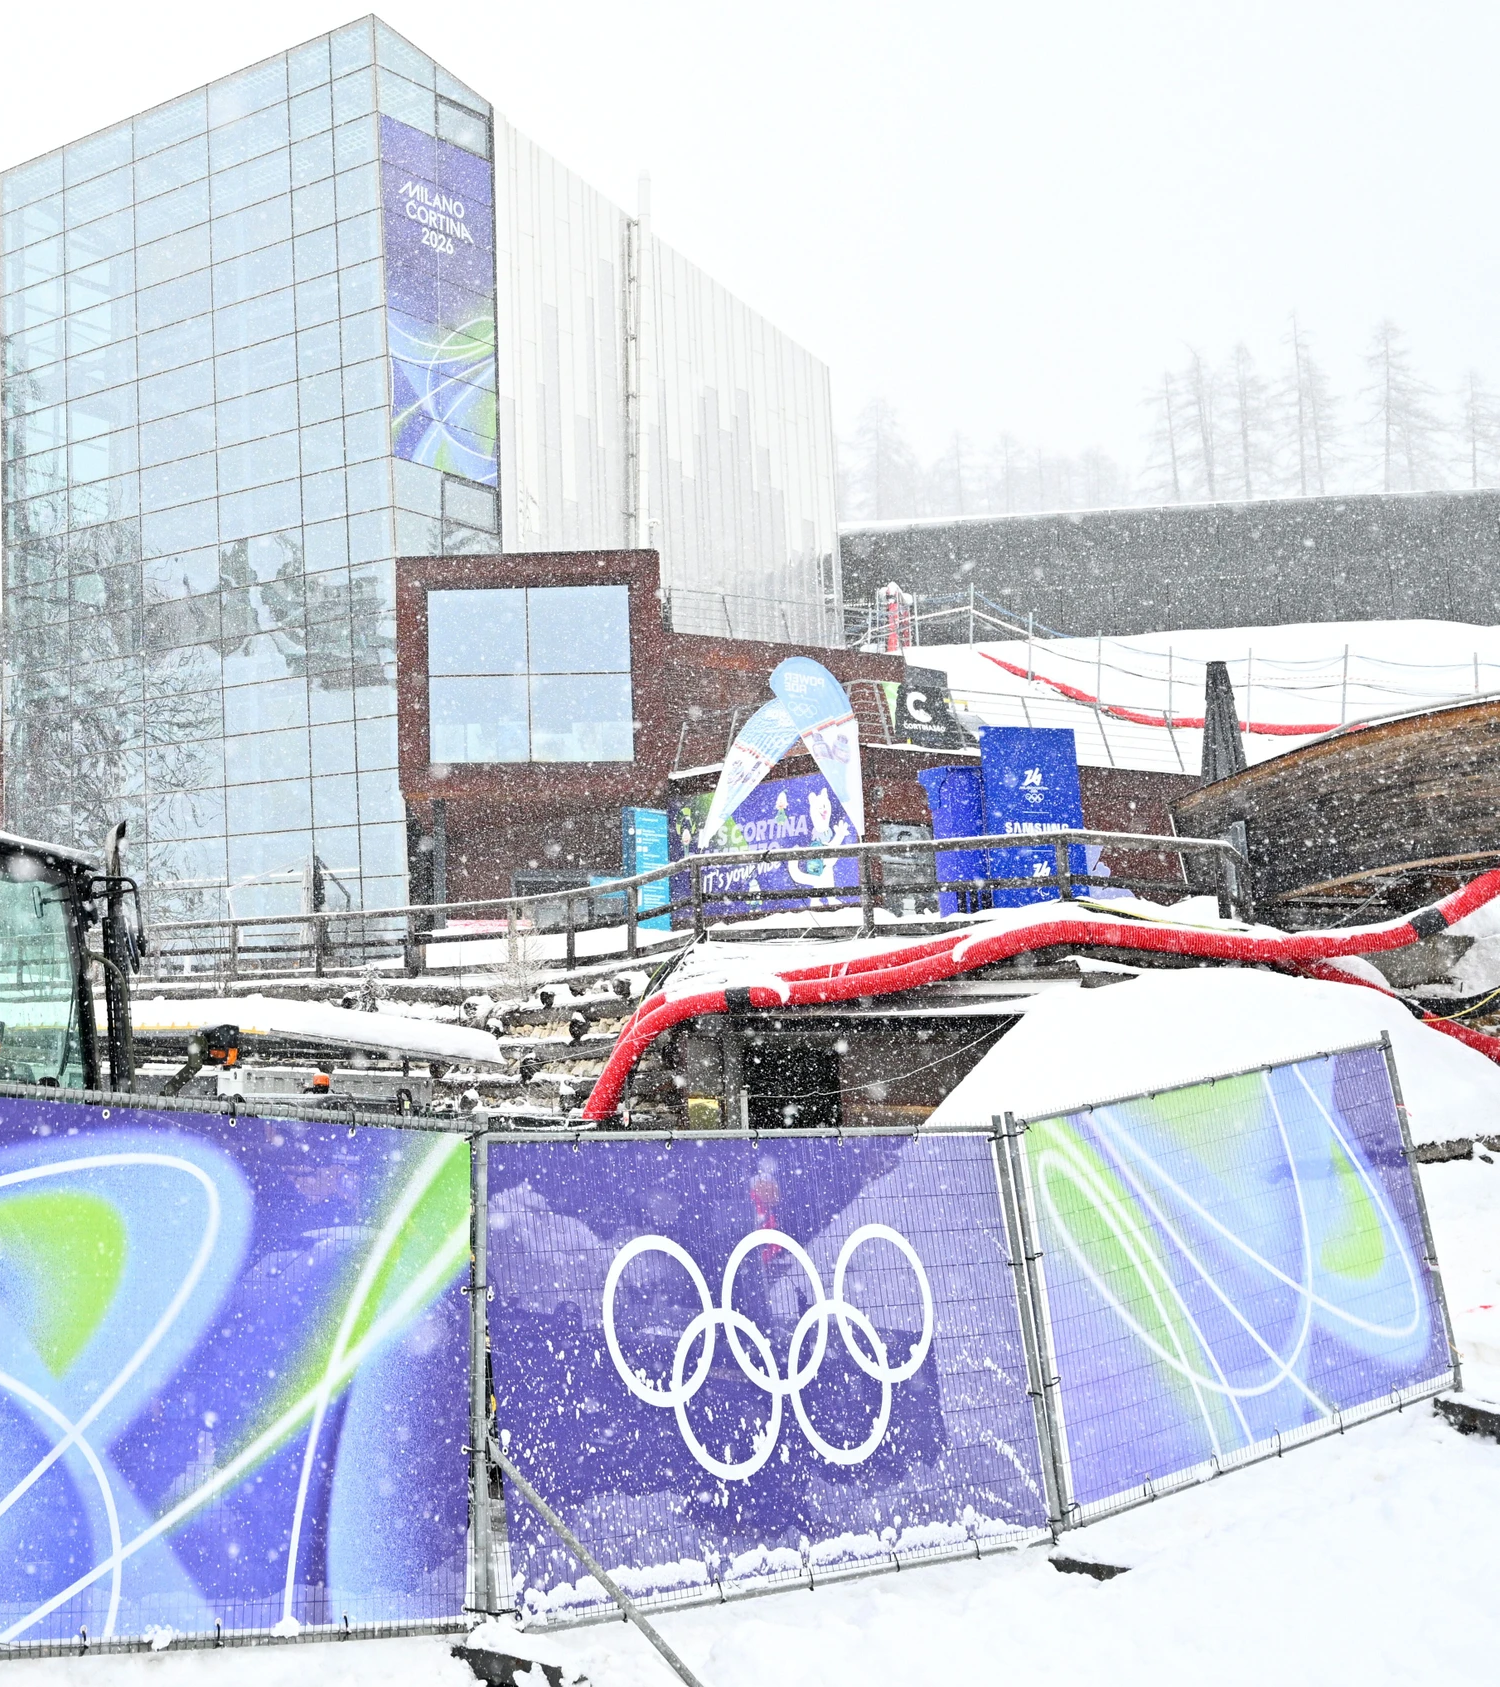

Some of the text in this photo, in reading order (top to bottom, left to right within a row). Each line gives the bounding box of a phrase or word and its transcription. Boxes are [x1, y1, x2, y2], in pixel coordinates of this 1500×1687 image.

[399, 181, 465, 219] MILANO
[405, 202, 474, 244] CORTINA
[421, 227, 454, 255] 2026
[731, 815, 808, 843] CORTINA
